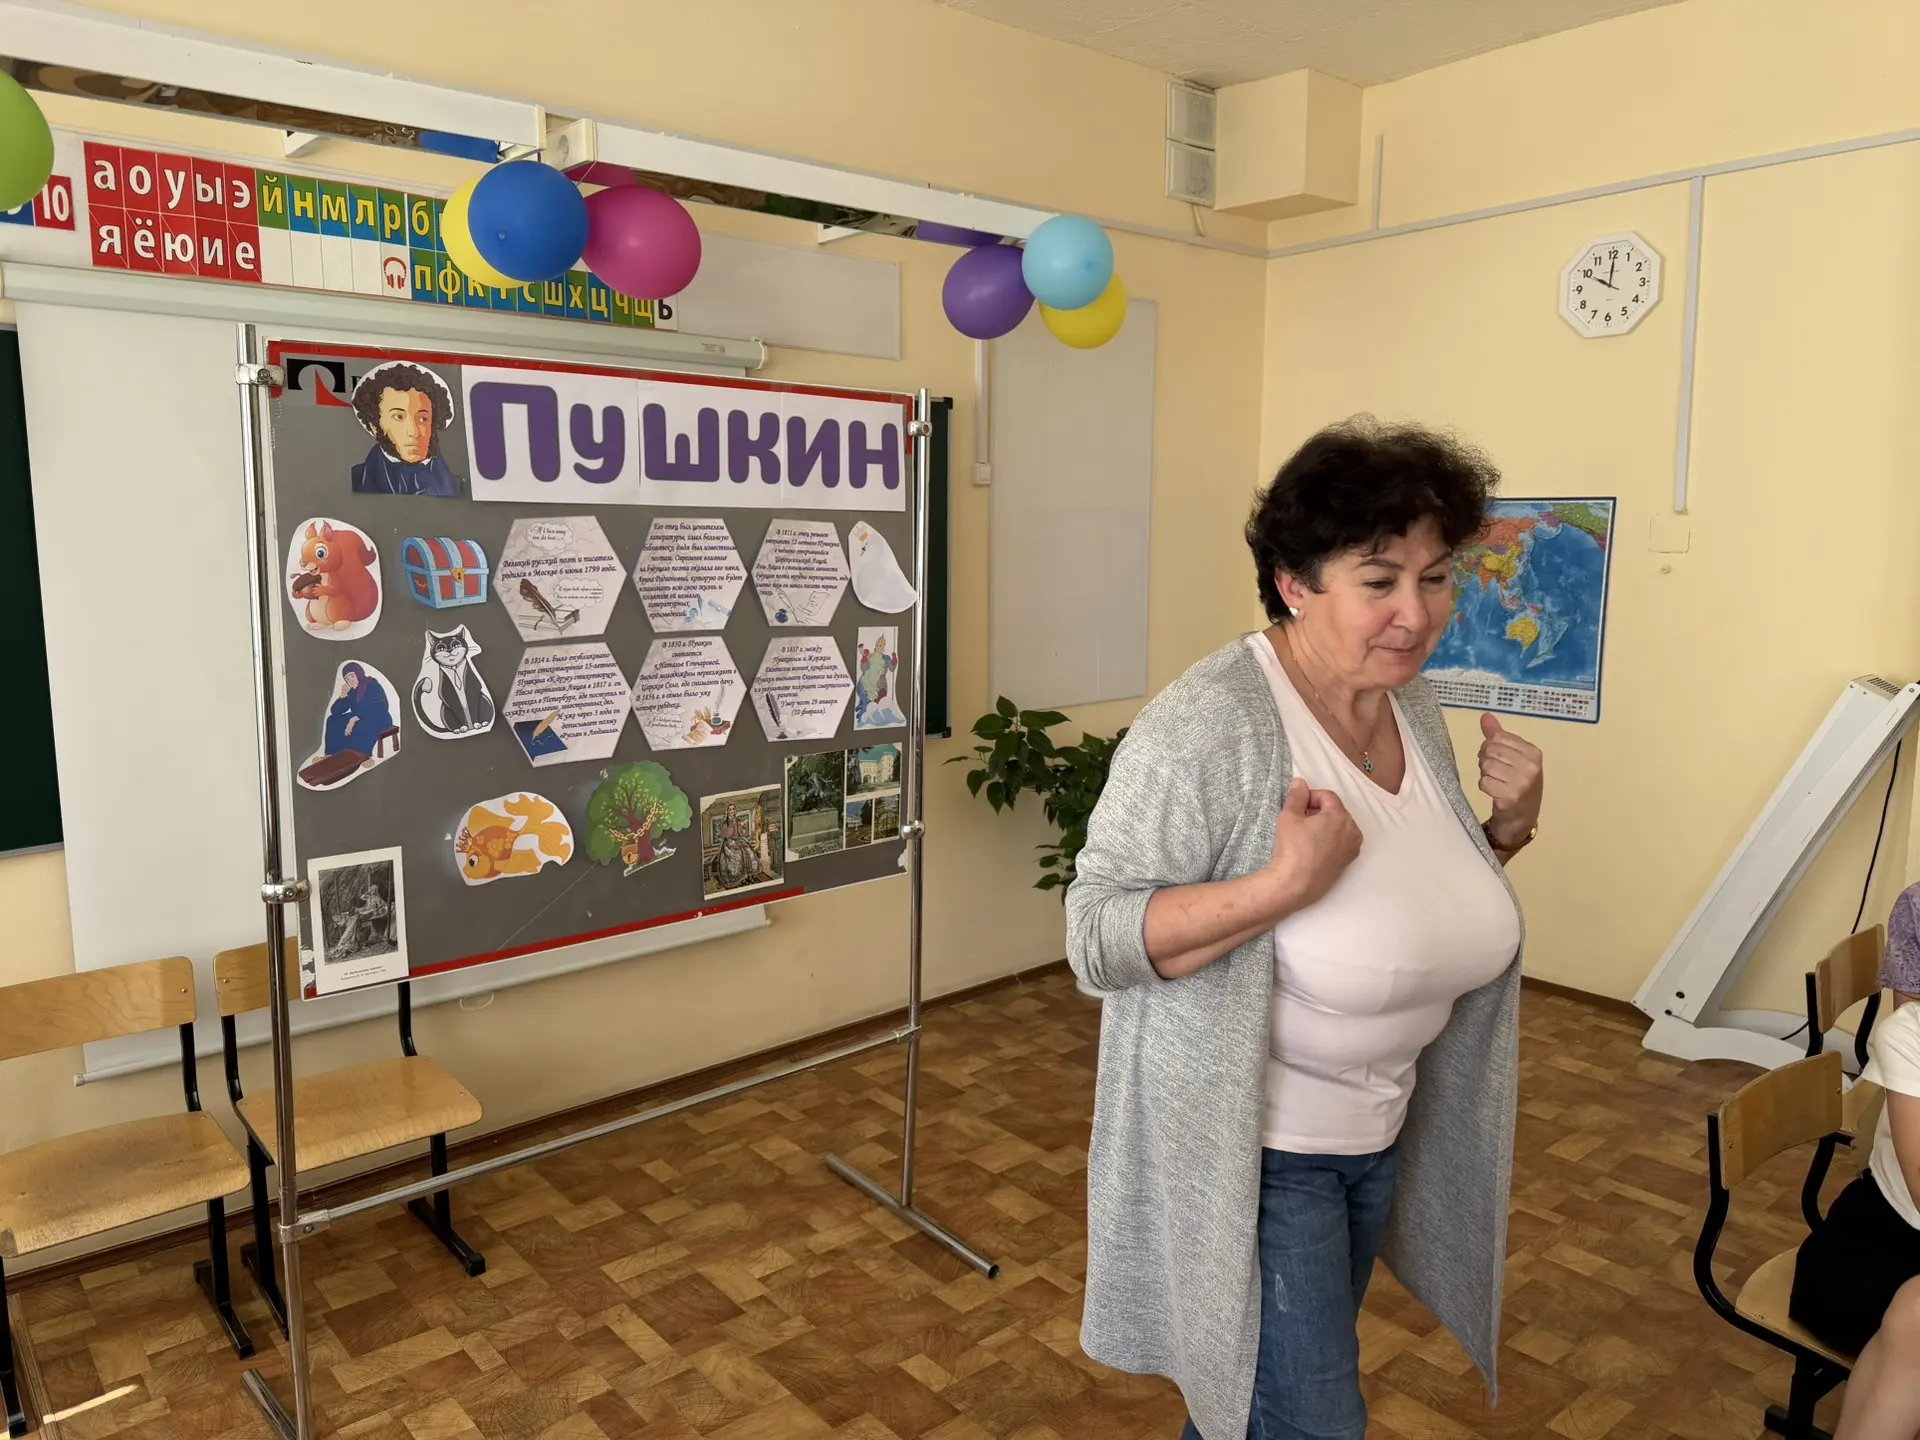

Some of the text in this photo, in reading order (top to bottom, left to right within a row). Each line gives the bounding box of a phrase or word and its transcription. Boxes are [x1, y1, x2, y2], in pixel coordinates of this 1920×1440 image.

[42, 184, 70, 221] 10
[1608, 250, 1618, 260] 12
[1626, 252, 1630, 262] 1
[1594, 256, 1602, 266] 11
[1636, 262, 1642, 272] 2
[1583, 269, 1592, 278] 10
[1639, 277, 1646, 287] 3
[1576, 285, 1582, 294] 9
[1632, 294, 1640, 303] 4
[1580, 300, 1586, 309] 8
[1591, 310, 1598, 320] 7
[1620, 306, 1628, 316] 5
[1604, 312, 1612, 322] 6
[470, 381, 900, 490] Пушкин
[502, 560, 530, 568] Великий
[532, 558, 557, 568] русский
[502, 570, 526, 580] родился
[560, 566, 564, 574] 6
[688, 640, 712, 648] Пушкин
